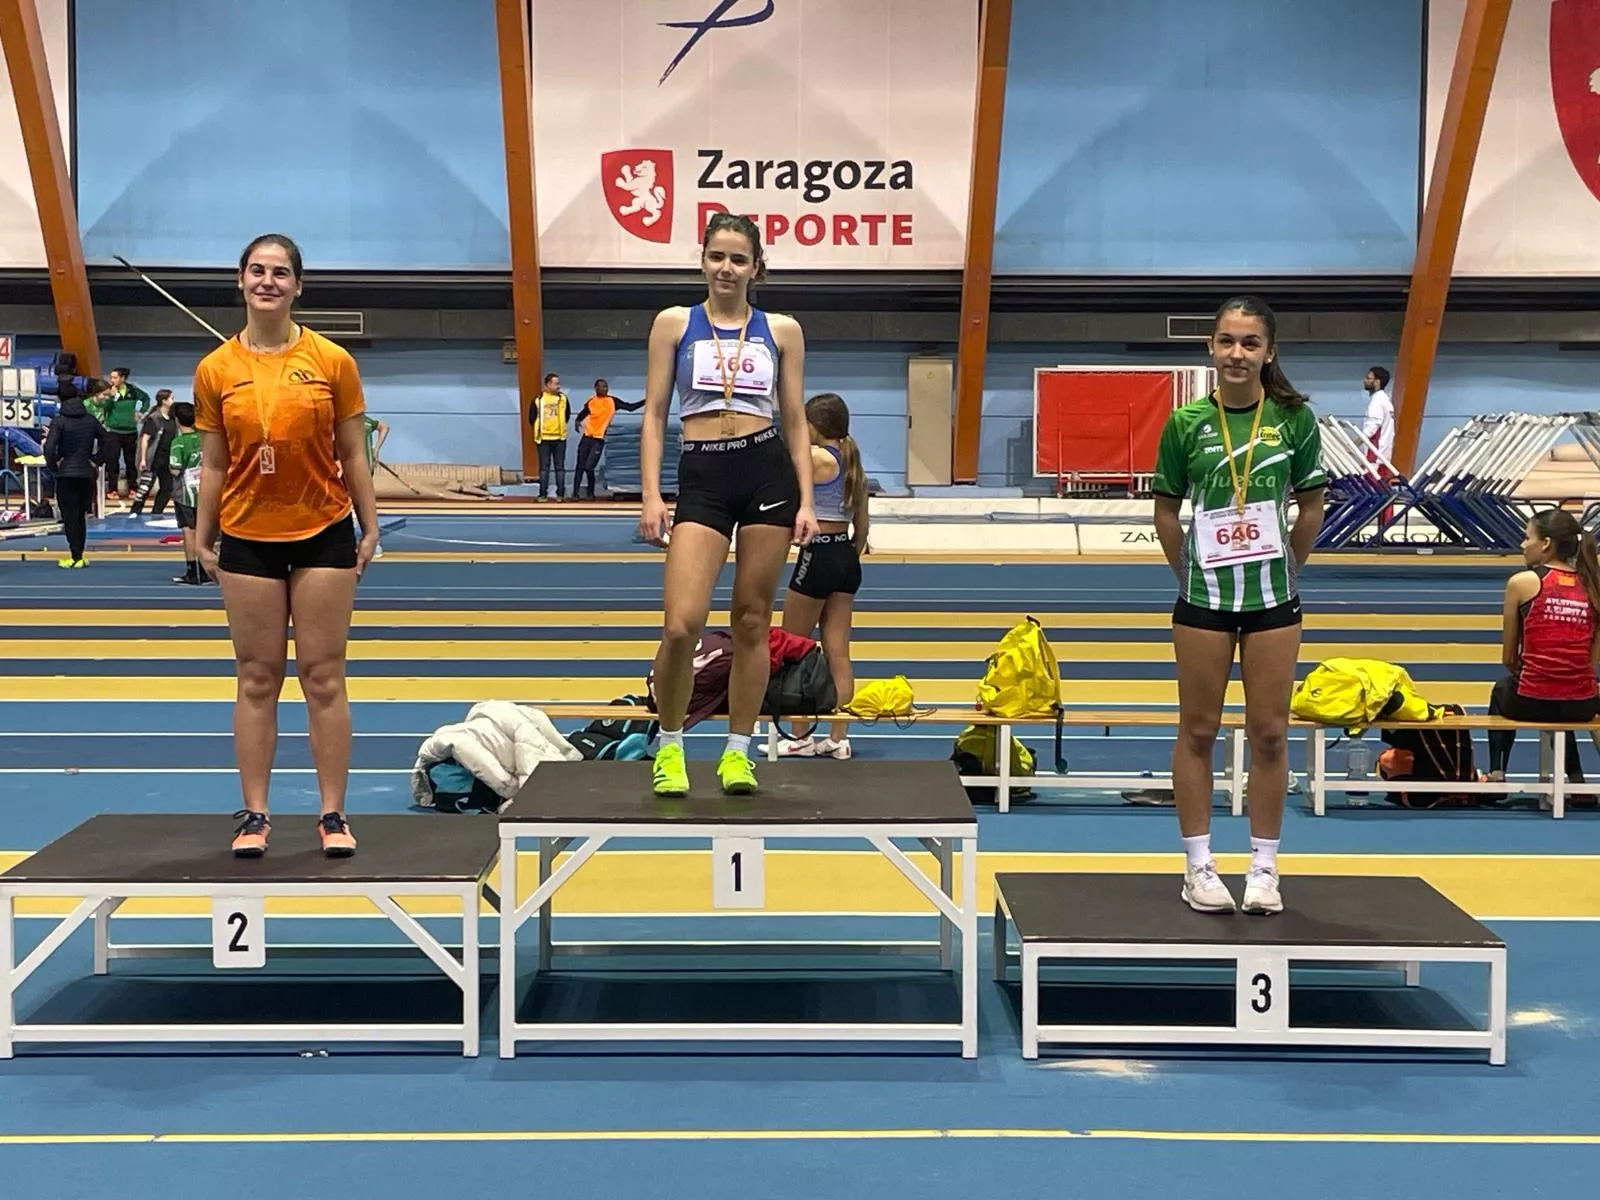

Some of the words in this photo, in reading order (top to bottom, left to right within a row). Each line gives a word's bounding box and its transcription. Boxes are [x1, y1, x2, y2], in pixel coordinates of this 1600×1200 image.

[697, 149, 913, 203] Zaragoza
[697, 202, 913, 246] DPORTE
[713, 355, 755, 373] 766
[701, 443, 725, 452] NIKE
[726, 440, 748, 451] PRO
[731, 852, 742, 892] 1
[227, 911, 249, 953] 2
[1251, 973, 1272, 1014] 3
